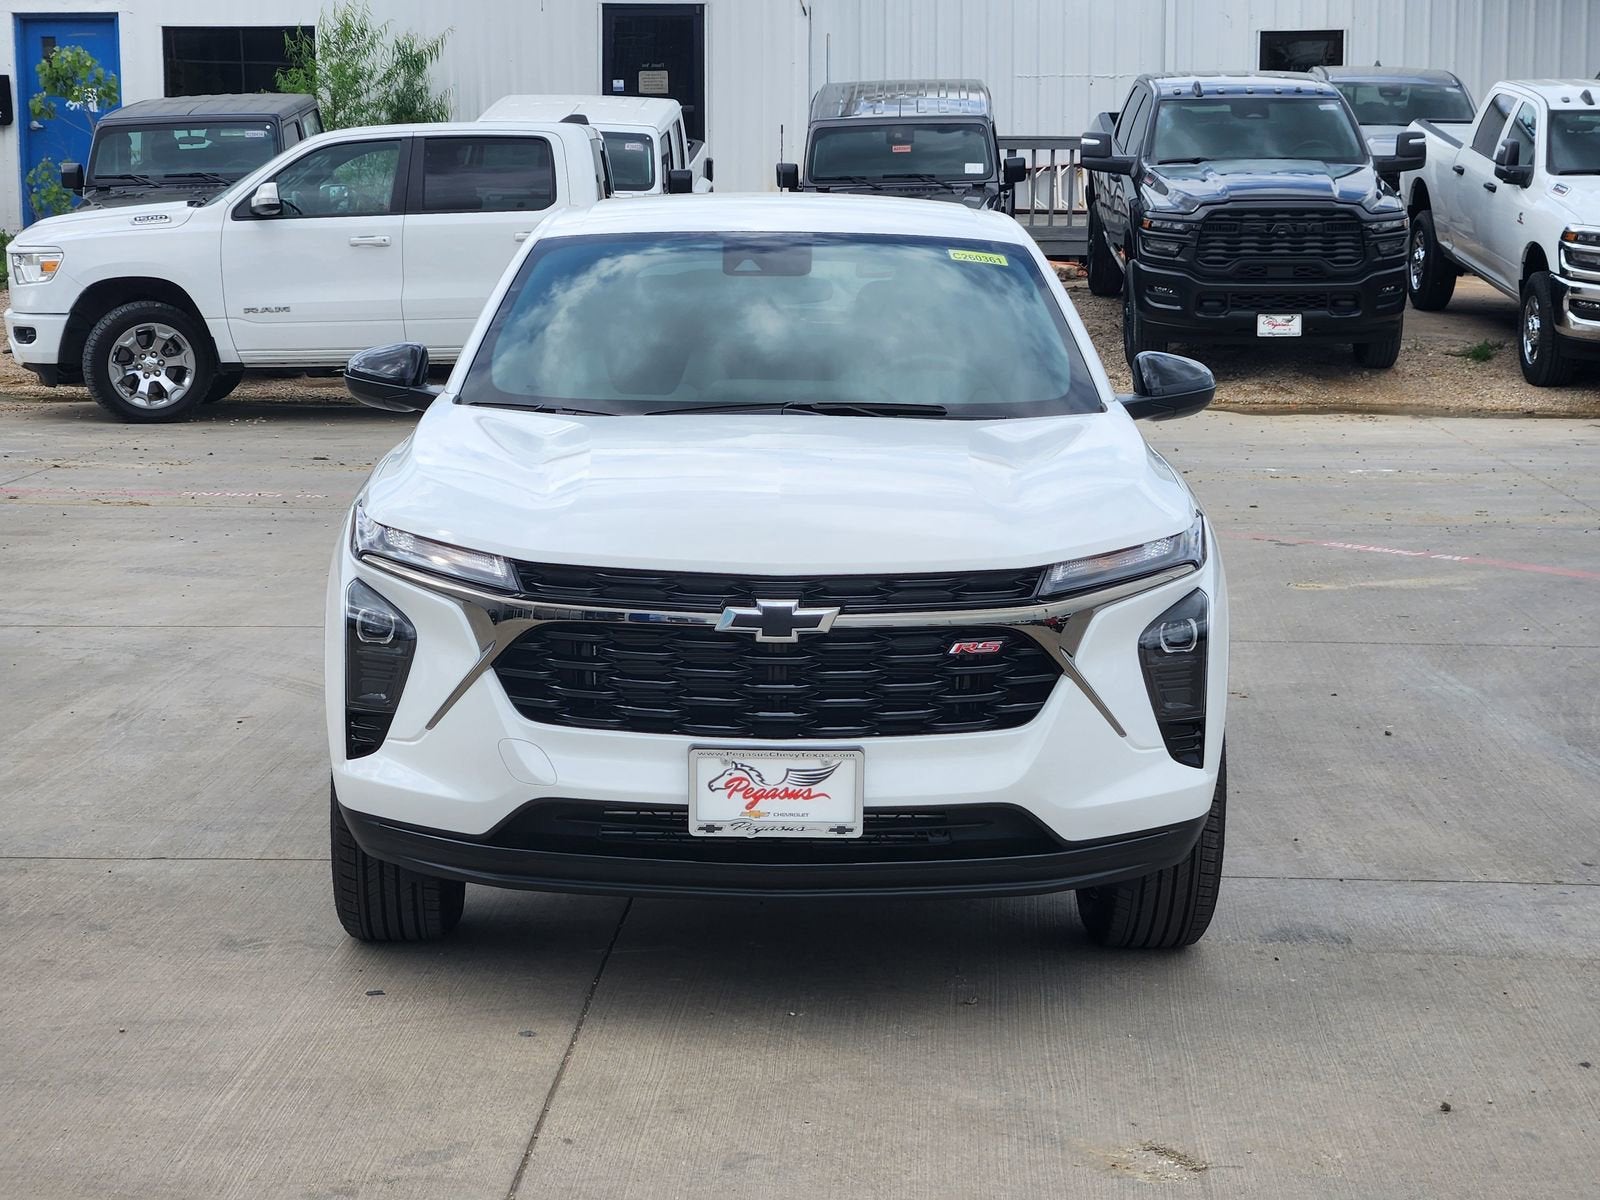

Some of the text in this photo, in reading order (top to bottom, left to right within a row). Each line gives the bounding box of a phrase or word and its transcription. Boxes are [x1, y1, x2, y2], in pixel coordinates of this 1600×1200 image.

[243, 306, 291, 314] RAM
[948, 640, 1004, 654] RS
[724, 776, 831, 811] Pegasus
[730, 821, 821, 836] Pegasus
